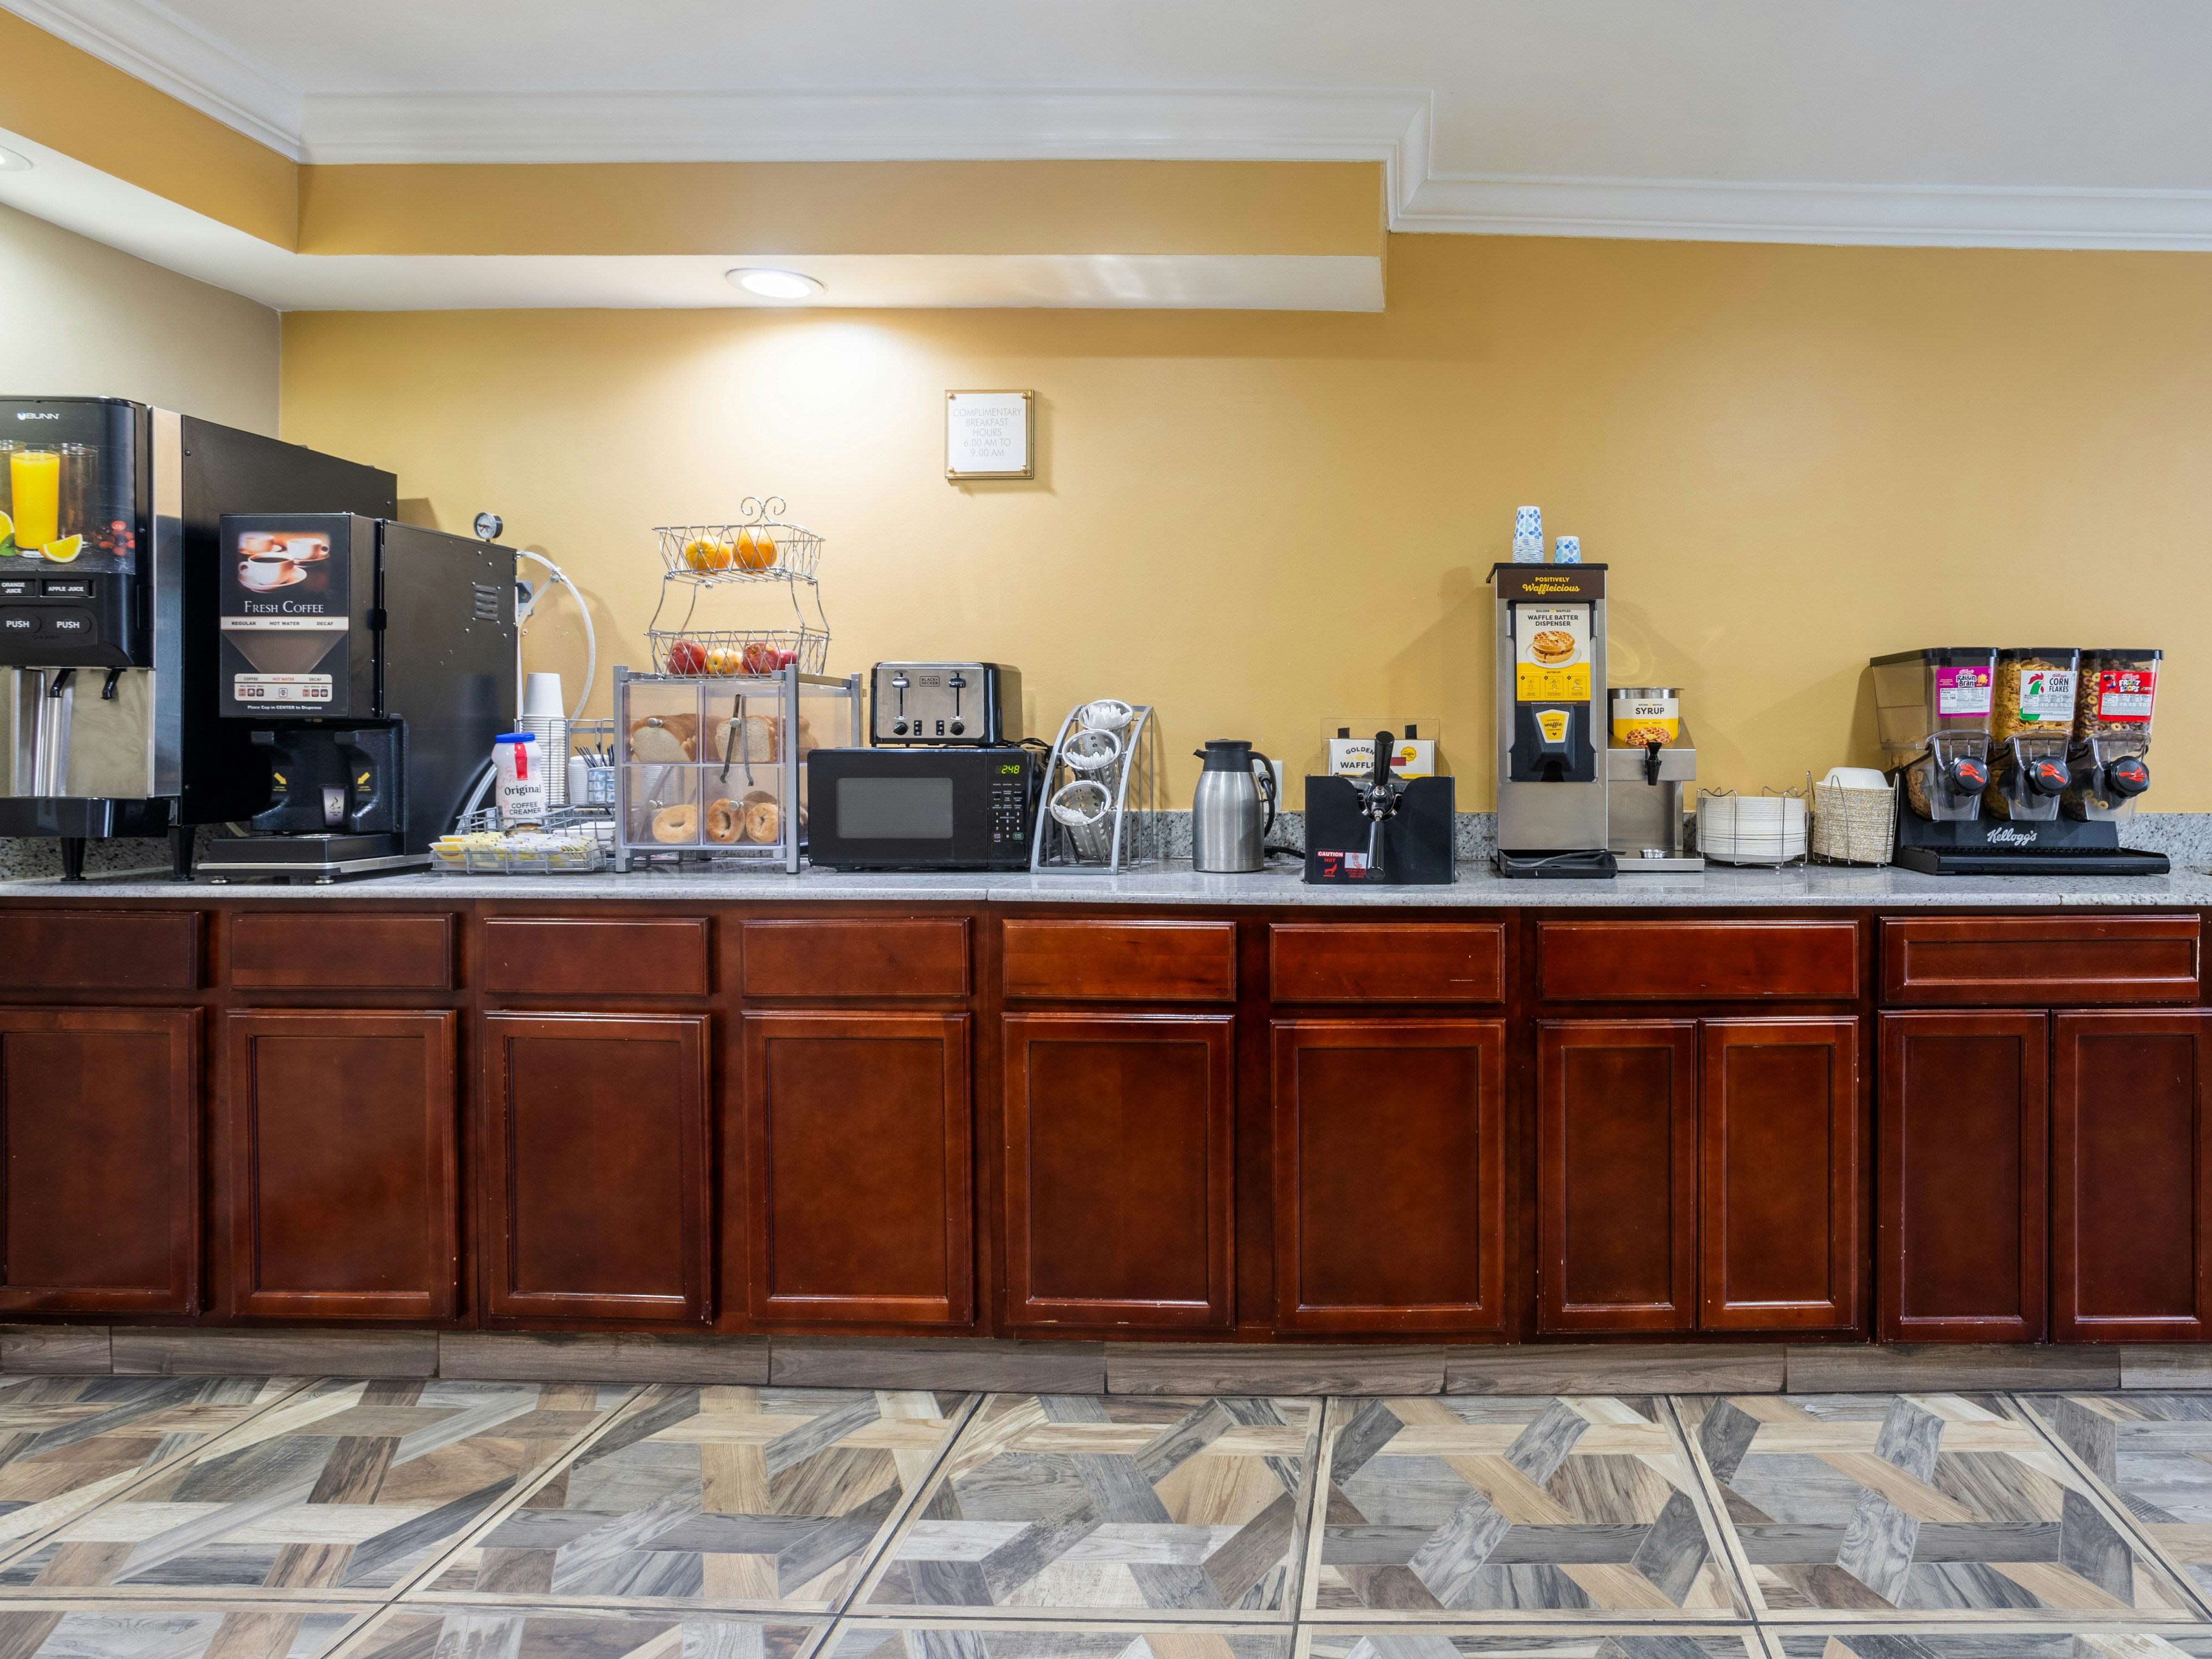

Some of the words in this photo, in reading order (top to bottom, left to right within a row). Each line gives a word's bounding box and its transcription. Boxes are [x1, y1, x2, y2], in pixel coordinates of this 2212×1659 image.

[953, 408, 1022, 417] COMPLIMENTARY
[966, 418, 1009, 426] BREAKFAST
[973, 428, 1002, 437] HOURS
[964, 439, 982, 447] 6.00
[1000, 438, 1011, 446] TO
[971, 448, 989, 457] 9.00
[1522, 583, 1580, 594] Waffleicious
[244, 601, 278, 613] FRESH
[283, 600, 324, 613] COFFEE
[1345, 747, 1375, 755] GOLDEN
[504, 784, 541, 796] Original
[1987, 827, 2037, 846] Kellogg's
